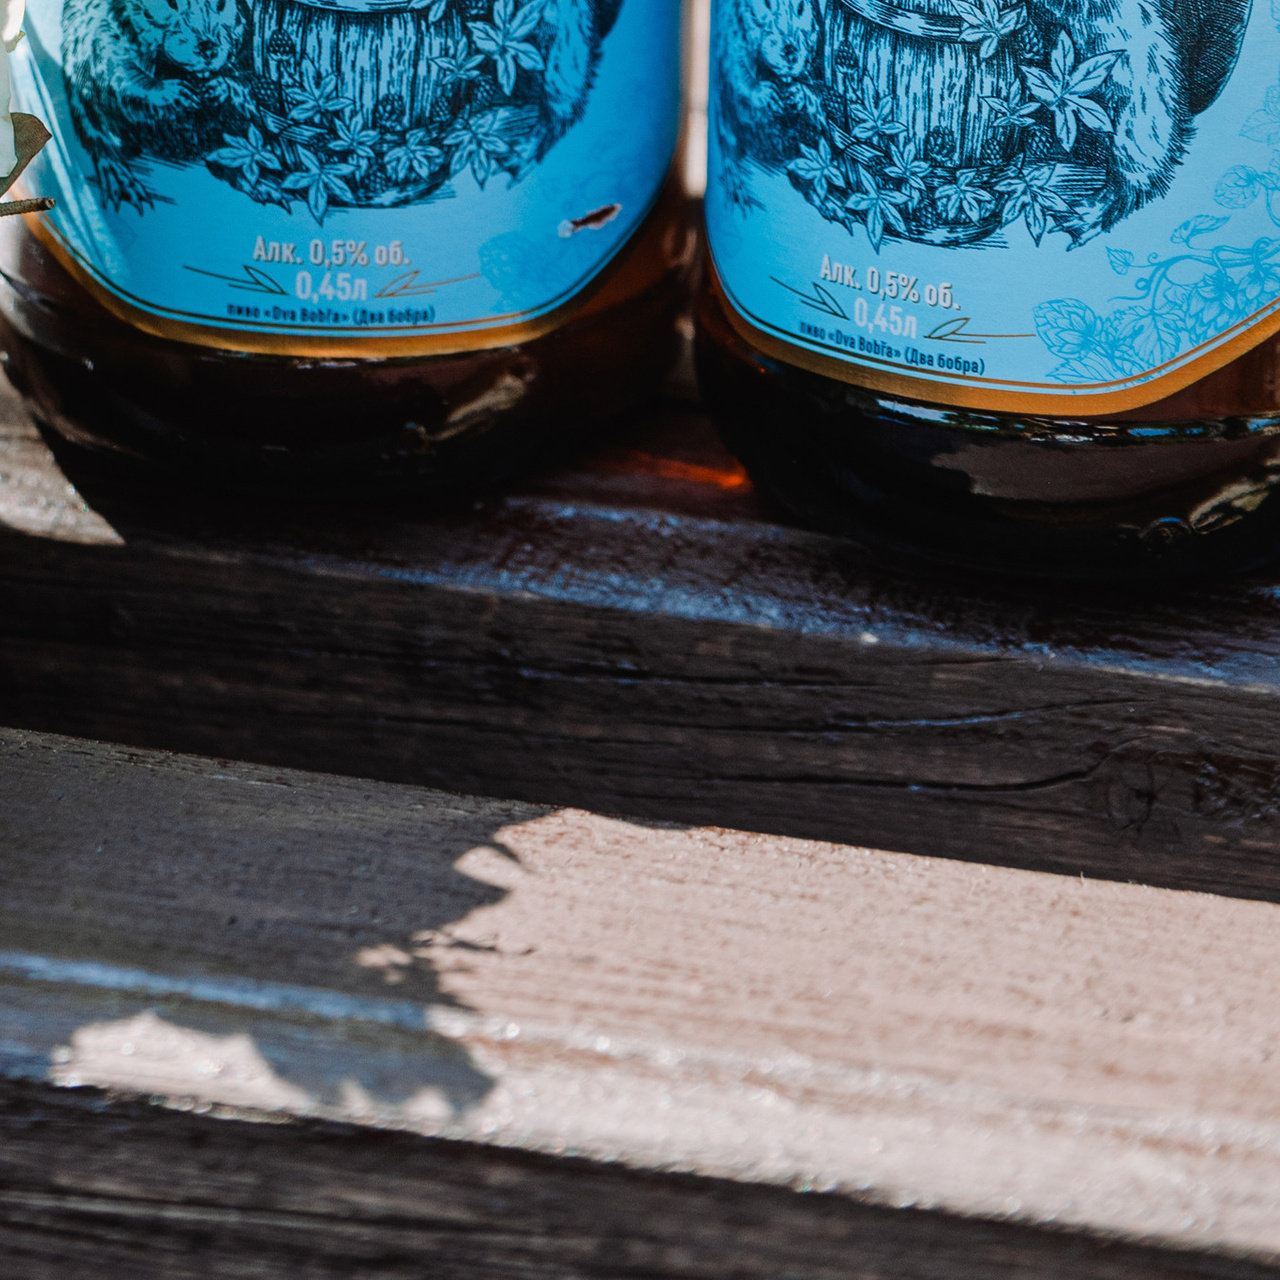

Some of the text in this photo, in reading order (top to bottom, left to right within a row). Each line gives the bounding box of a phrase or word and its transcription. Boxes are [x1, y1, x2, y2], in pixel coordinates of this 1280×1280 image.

[253, 235, 412, 270] Алк. 0,5% об.
[295, 270, 367, 305] 0,45л
[820, 253, 961, 311] Алк. 0,5% об.
[854, 297, 917, 339] 0,45л
[904, 346, 934, 366] (Два
[937, 353, 986, 376] бобра)
